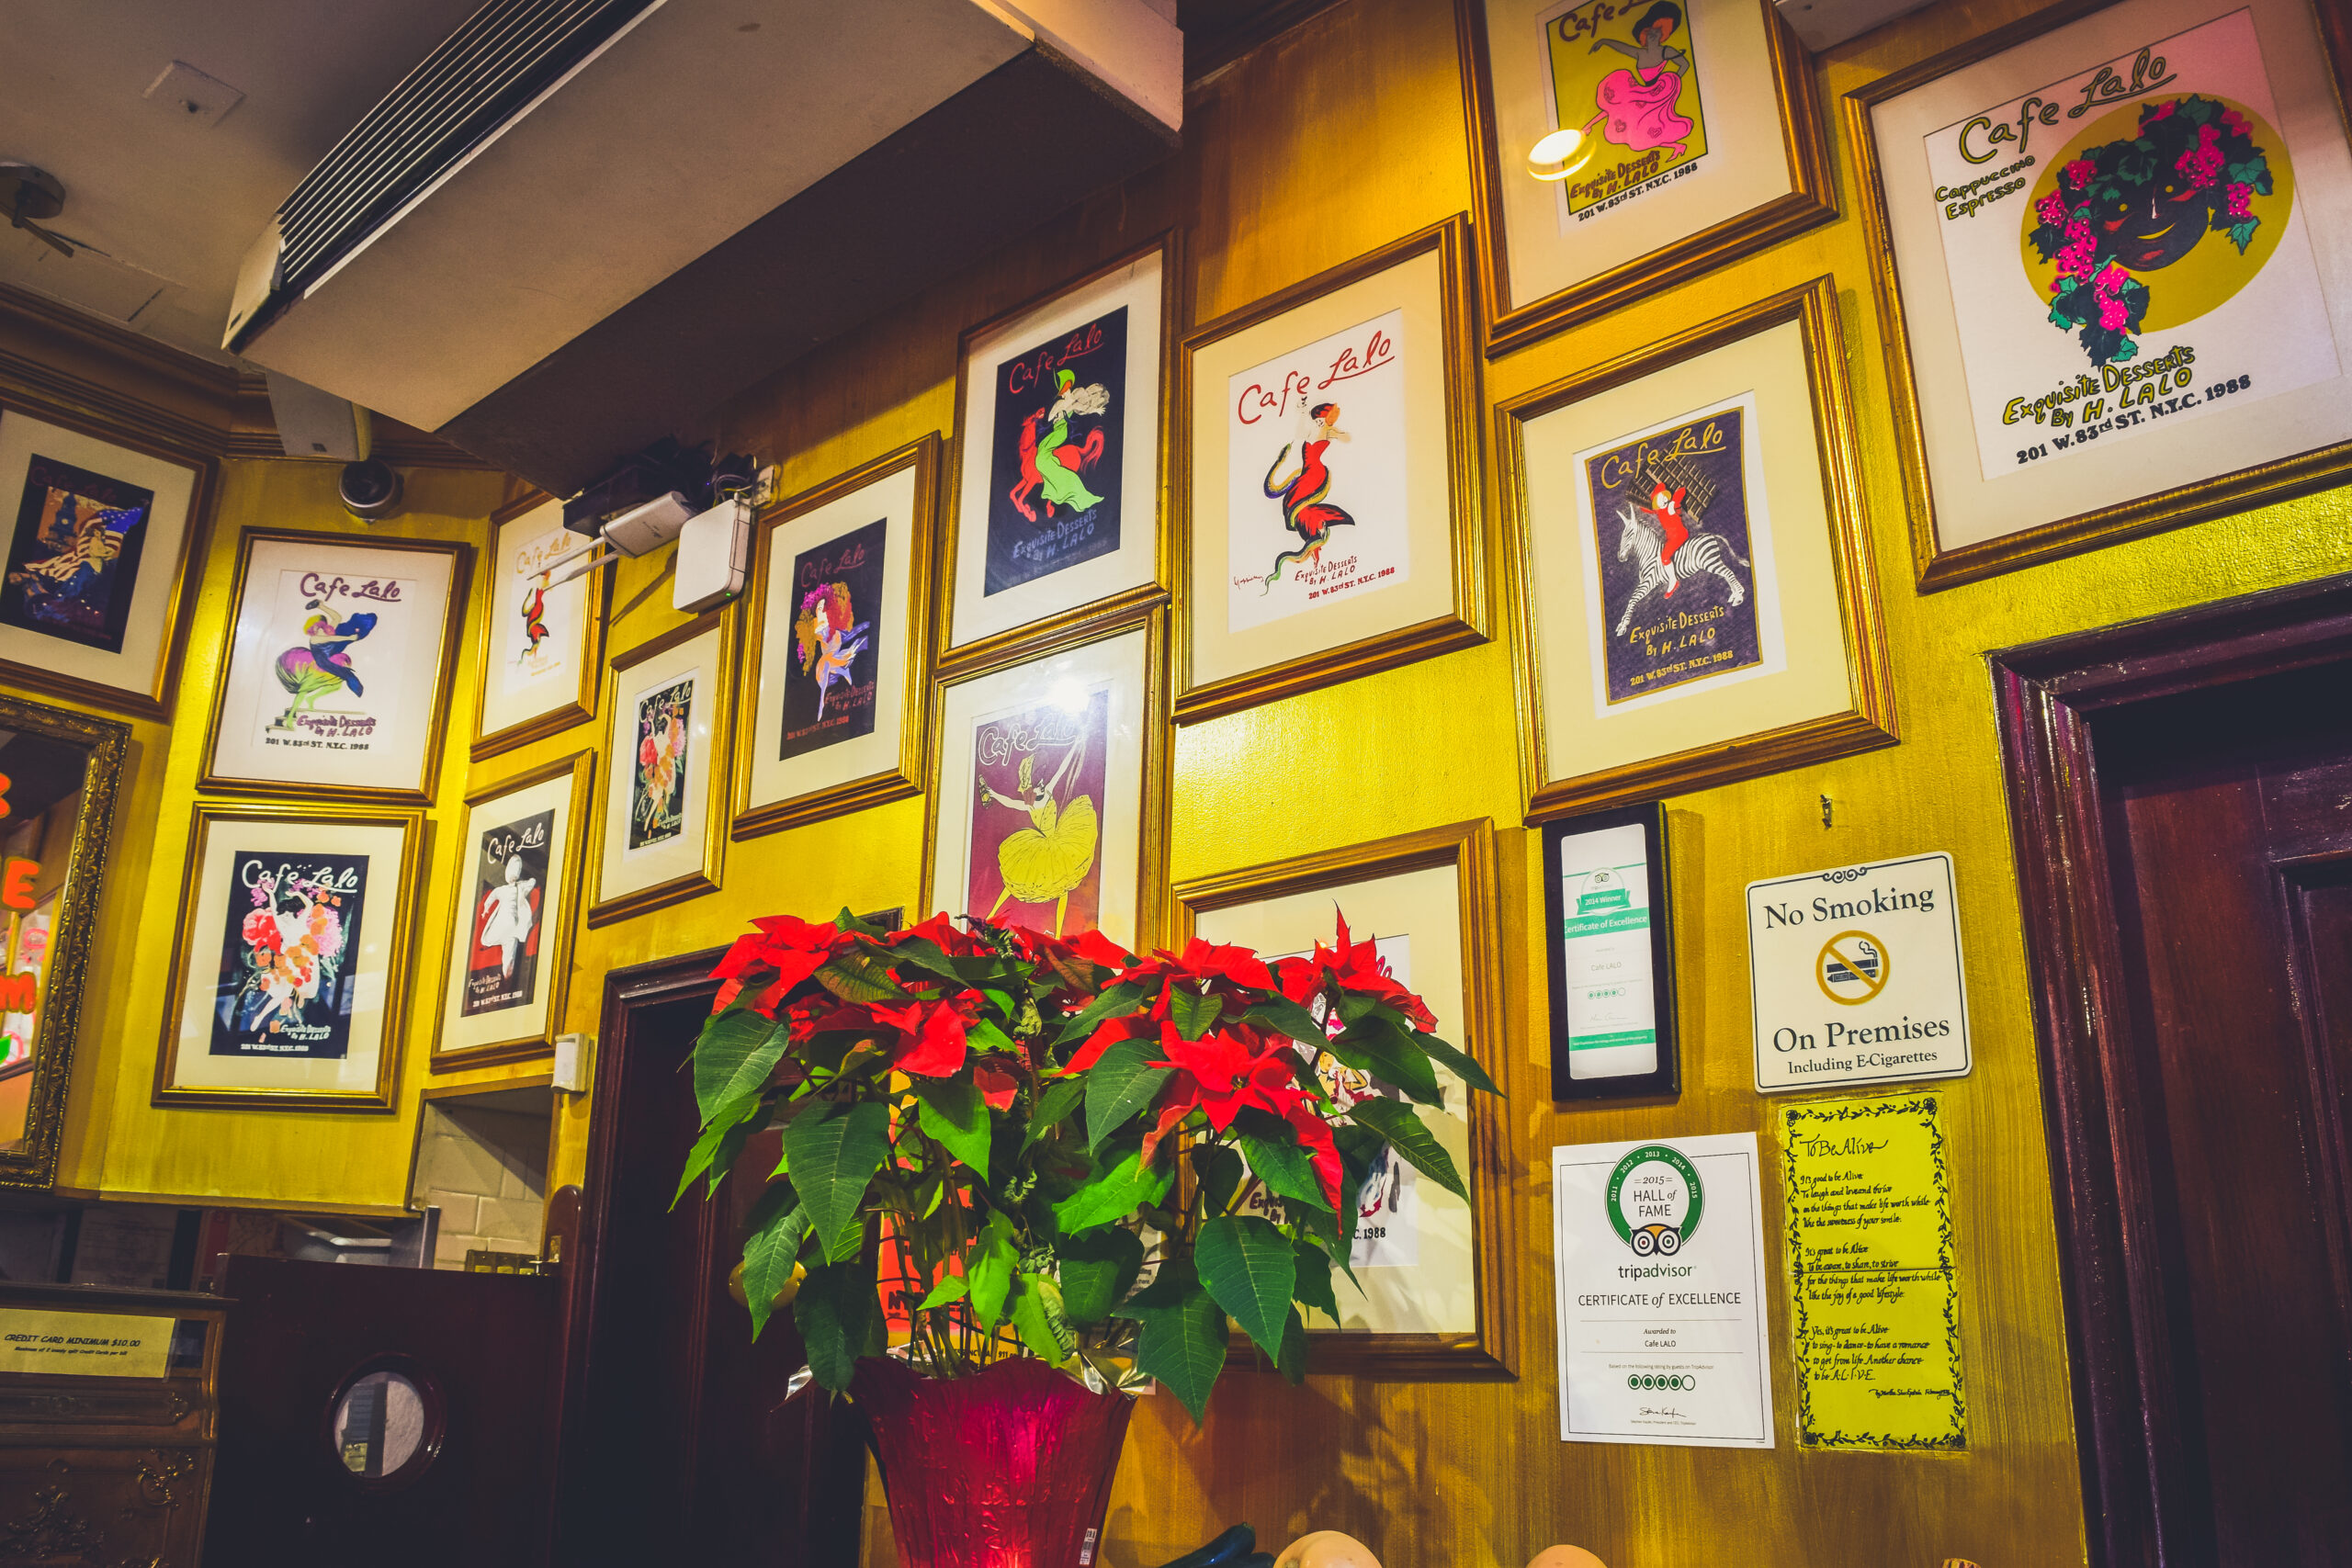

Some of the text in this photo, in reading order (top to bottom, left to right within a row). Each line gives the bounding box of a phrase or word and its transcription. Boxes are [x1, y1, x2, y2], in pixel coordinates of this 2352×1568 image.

[1559, 3, 1615, 42] Cafe
[1959, 47, 2177, 165] Cafe Lalo
[1623, 161, 1659, 187] LALO
[1577, 208, 1595, 221] 201
[1596, 201, 1608, 213] W.
[1628, 186, 1645, 199] ST.
[1673, 162, 1698, 180] 1988
[1009, 323, 1104, 394] Cafe Lalo
[1238, 330, 1396, 424] Cafe Lalo
[2119, 367, 2193, 409] LALO
[2016, 374, 2252, 464] 201 W. 83rd ST. N.Y.C. 1988
[1600, 422, 1727, 489] Cafe Lalo
[1062, 523, 1094, 549] LALO
[801, 544, 866, 588] Cafe Lalo
[1331, 564, 1356, 581] LALO
[300, 572, 401, 602] Cafe Lalo
[1308, 591, 1320, 600] 201
[1378, 566, 1396, 579] 1988
[1679, 626, 1716, 649] LALO
[1629, 676, 1645, 687] 201
[1673, 661, 1687, 673] ST.
[1713, 649, 1734, 663] 1988
[639, 681, 692, 723] Cafe Lalo
[342, 727, 373, 737] LALO
[978, 723, 1028, 766] Cafe
[487, 822, 545, 864] Cafe Lalo
[242, 860, 358, 894] Cafe Lalo
[1585, 895, 1622, 906] 2014 Winner
[1764, 887, 1935, 929] No Smoking
[1600, 919, 1608, 929] of
[1609, 916, 1647, 927] Excellence
[1773, 1016, 1950, 1053] On Premises
[1788, 1052, 1938, 1074] Including E-Cigarettes
[1800, 1134, 1889, 1156] To Be Alive
[1620, 1159, 1634, 1174] 2012
[1671, 1156, 1687, 1171] 2014
[1690, 1181, 1698, 1199] 2015
[1642, 1176, 1665, 1185] 2015
[1811, 1172, 1827, 1188] good
[1842, 1170, 1864, 1181] Alive
[1634, 1190, 1678, 1202] HALL of
[1843, 1200, 1858, 1211] that
[1638, 1204, 1672, 1217] FAME
[1363, 1227, 1386, 1239] 1988
[1618, 1263, 1692, 1281] tripadvisor
[1578, 1292, 1741, 1308] CERTIFICATE of EXCELLENCE
[1856, 1289, 1874, 1305] good
[5, 1334, 39, 1342] CREDIT
[40, 1336, 64, 1344] CARD
[66, 1337, 108, 1347] MINIMUM
[1644, 1327, 1668, 1336] Awarded
